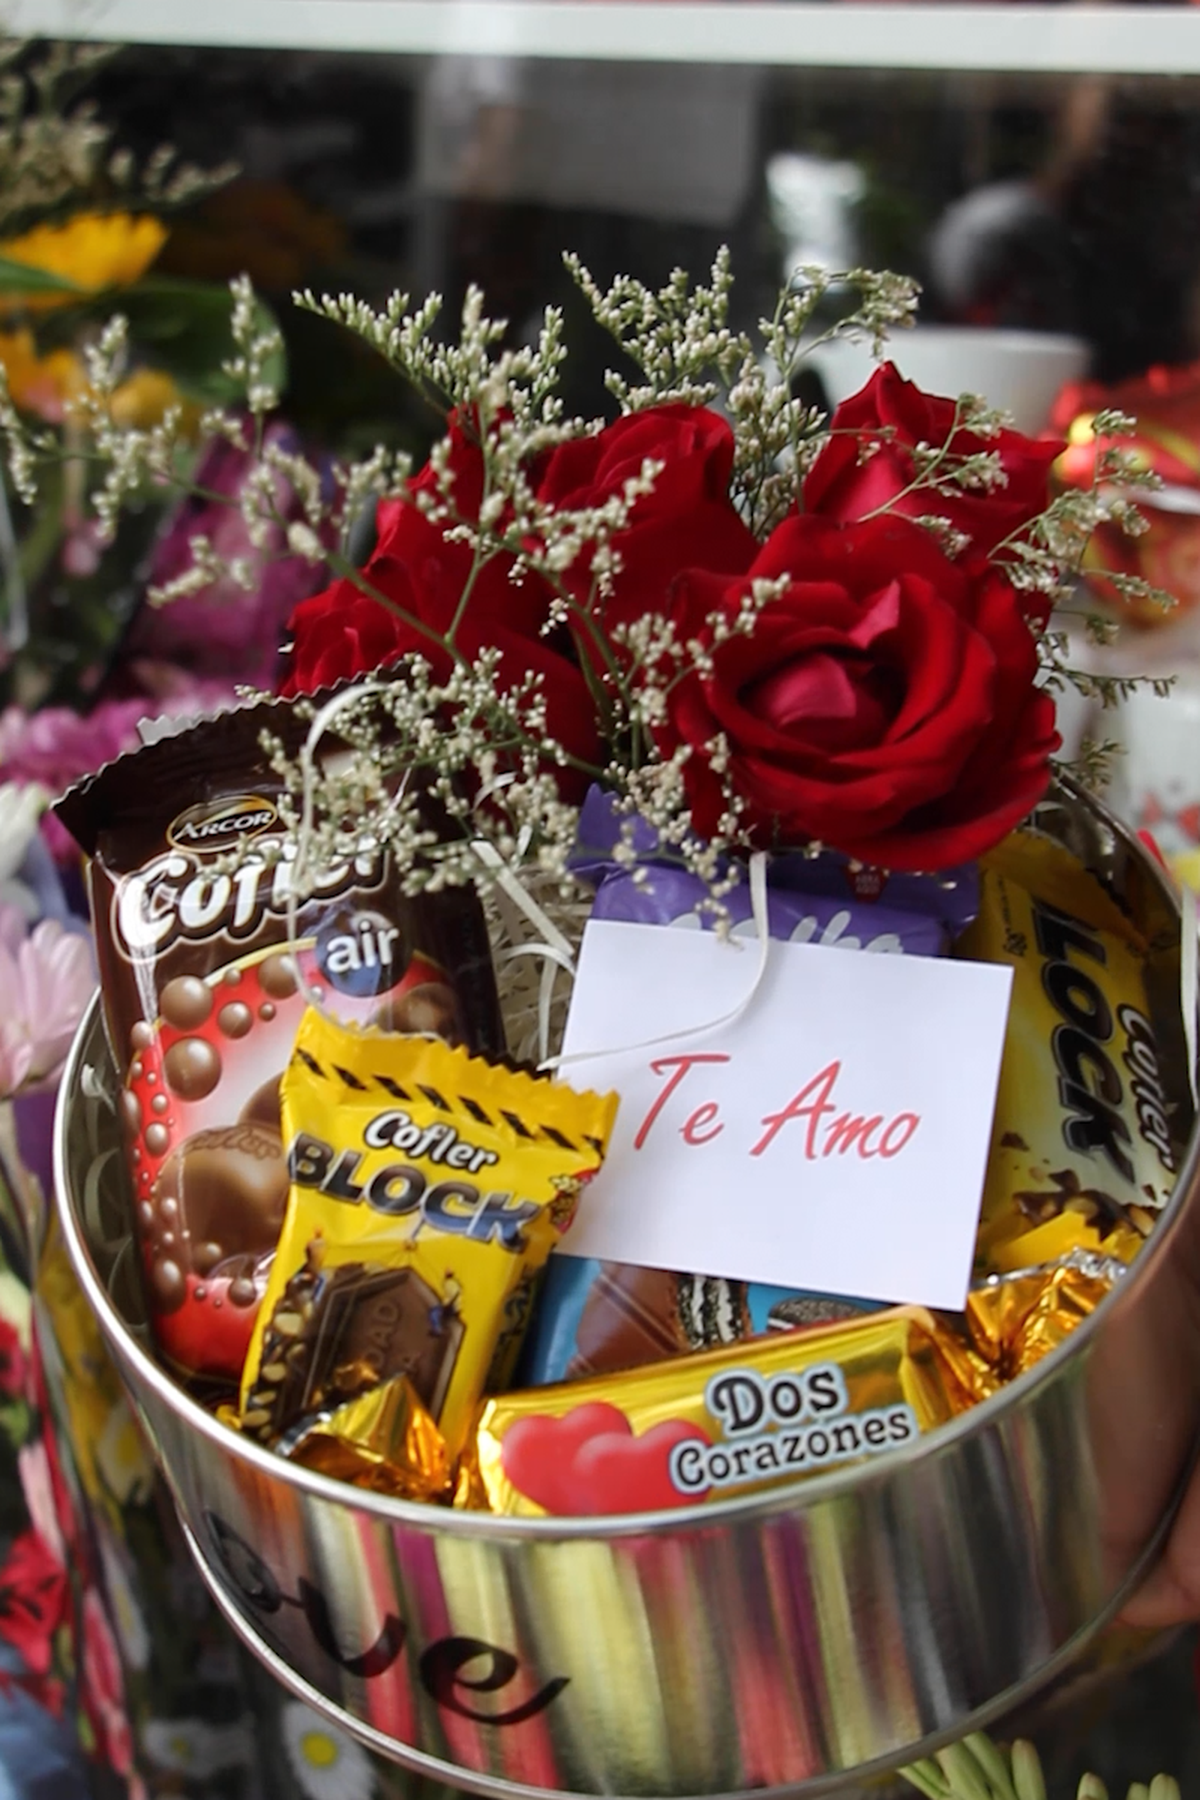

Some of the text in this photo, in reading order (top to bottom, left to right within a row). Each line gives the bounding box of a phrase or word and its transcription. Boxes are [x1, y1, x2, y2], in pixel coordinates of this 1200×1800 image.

[172, 811, 273, 842] ARCOR
[326, 919, 399, 973] air
[1030, 895, 1136, 1185] LOCK
[633, 1053, 922, 1160] Te Amo
[1115, 1003, 1176, 1174] Cofler
[364, 1109, 499, 1174] Cofler
[287, 1131, 542, 1253] BLOCK
[708, 1366, 843, 1434] Dos
[672, 1408, 914, 1489] Corazones
